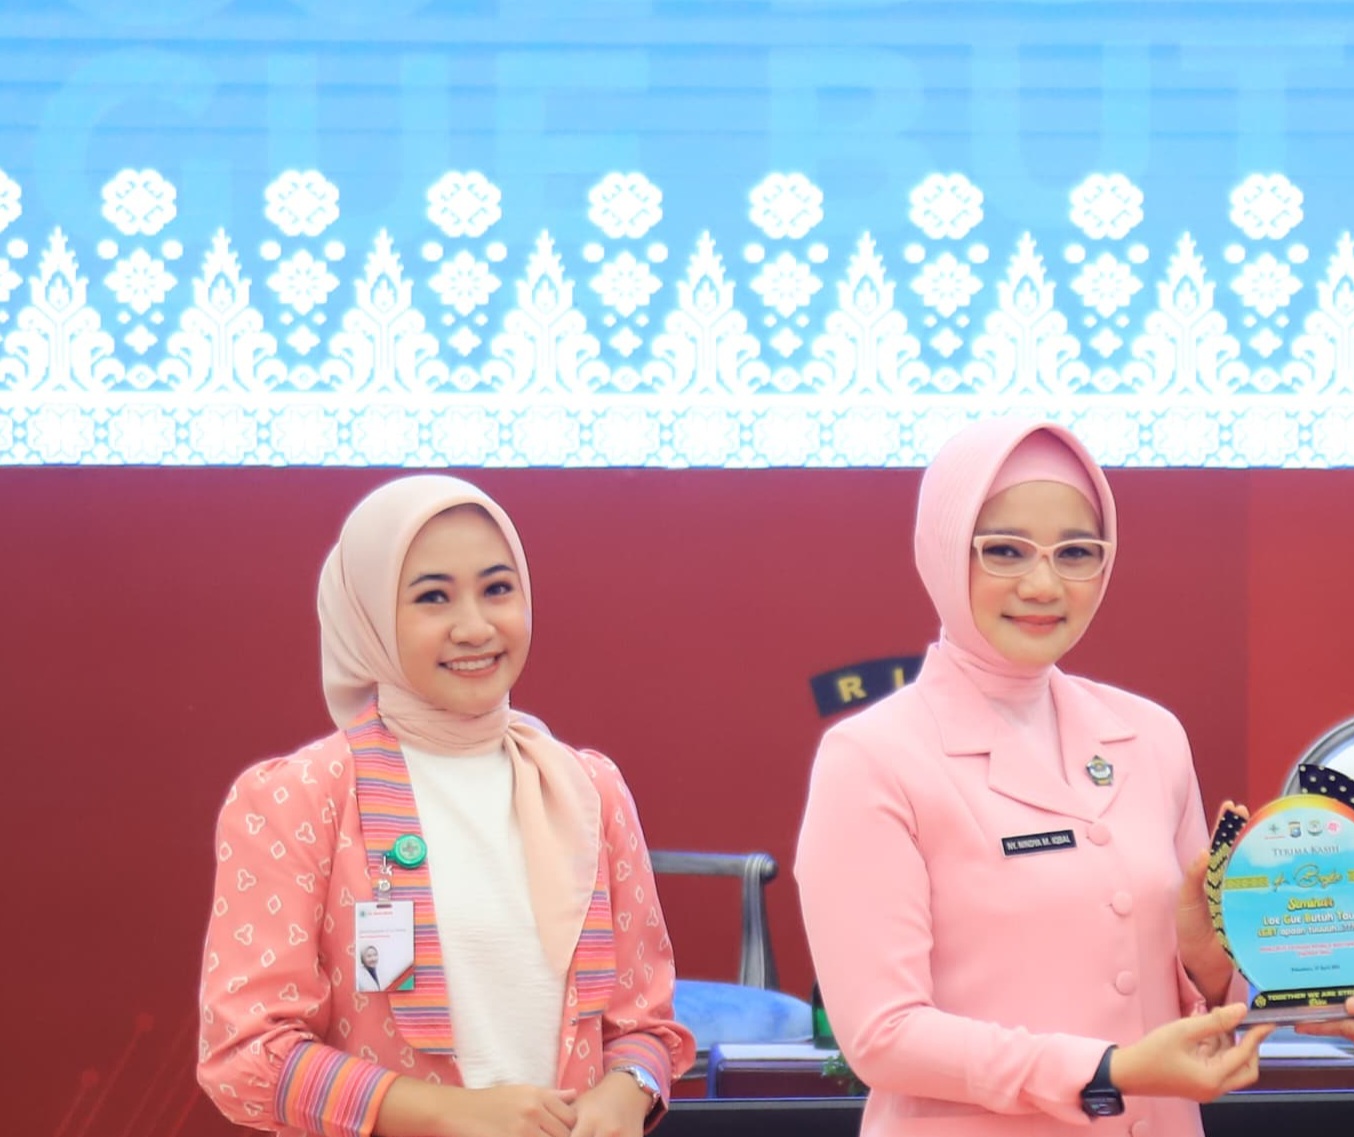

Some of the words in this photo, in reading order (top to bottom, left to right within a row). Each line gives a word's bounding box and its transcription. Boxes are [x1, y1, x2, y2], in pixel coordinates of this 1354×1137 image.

[34, 44, 652, 236] GUE
[1273, 847, 1309, 857] TERIMA
[1311, 844, 1340, 854] KASIH
[1283, 913, 1302, 925] Gue
[1304, 911, 1334, 923] Butuh
[1307, 991, 1320, 999] WE
